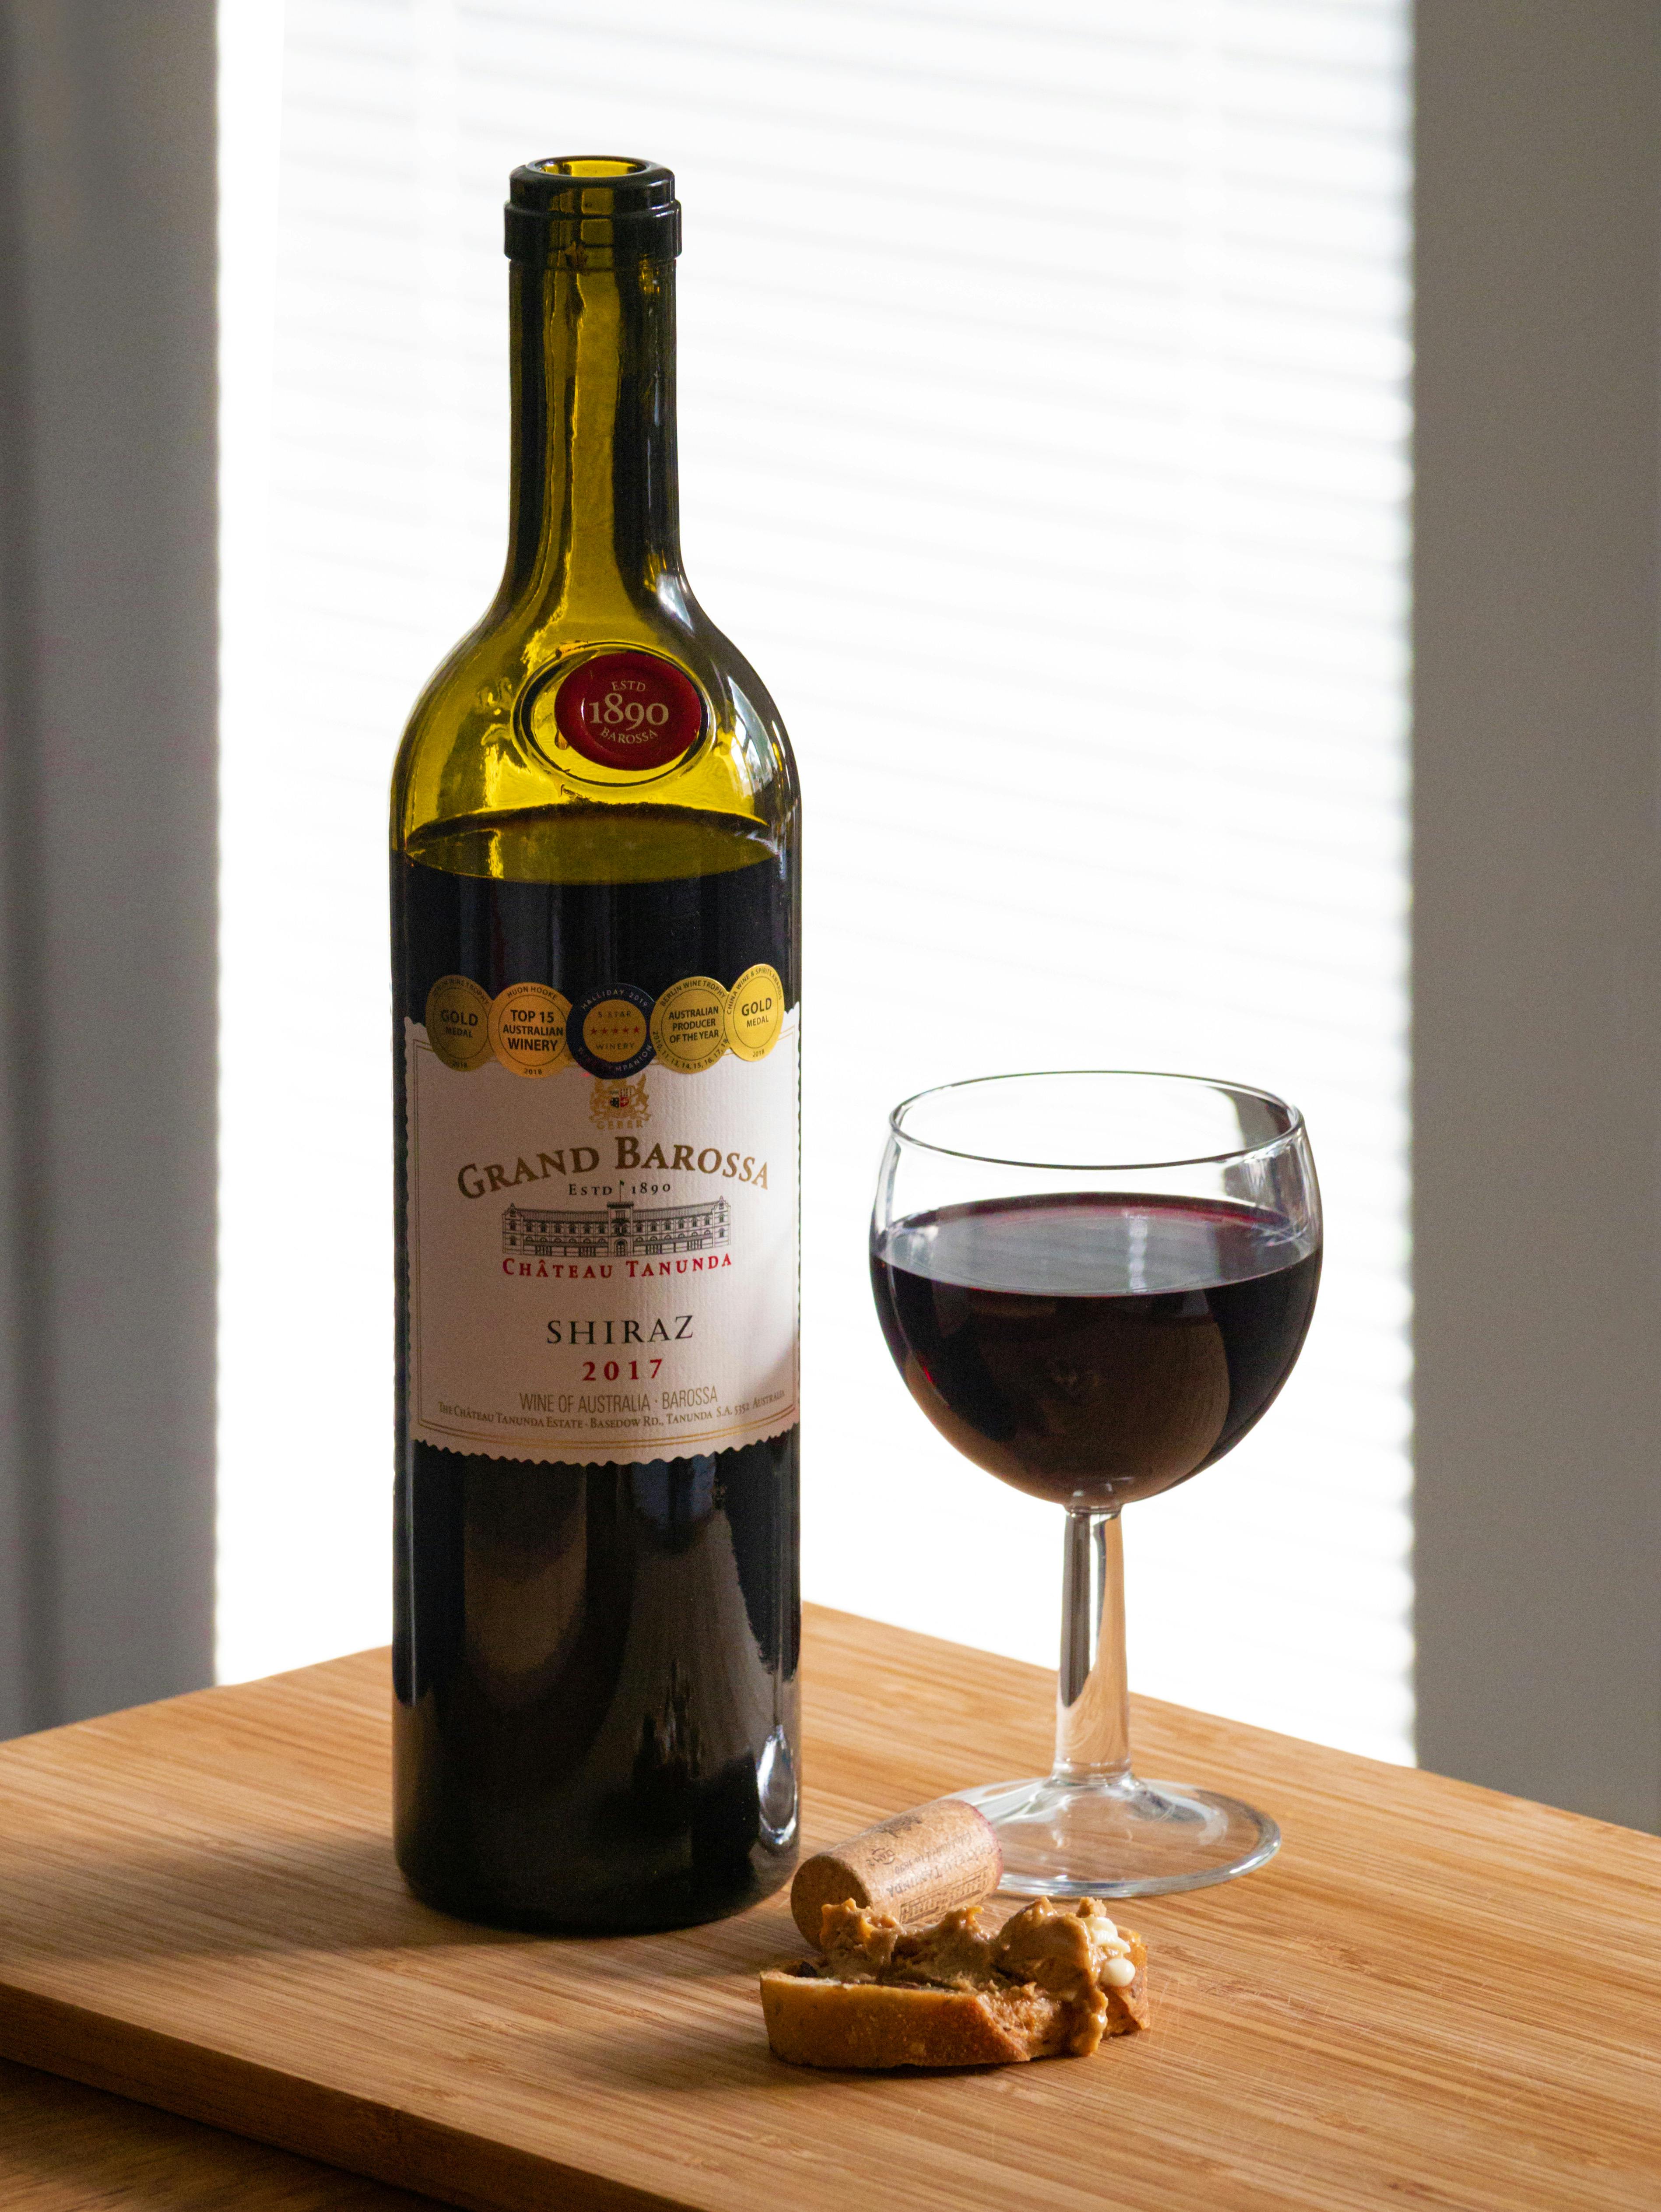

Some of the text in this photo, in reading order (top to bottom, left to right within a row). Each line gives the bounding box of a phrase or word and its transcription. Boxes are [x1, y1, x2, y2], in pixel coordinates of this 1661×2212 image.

[611, 680, 646, 692] ESTD
[589, 693, 669, 731] 1890
[600, 727, 658, 744] BAROSSA
[507, 986, 557, 1000] HUON HOOKE
[581, 989, 648, 1009] HALLIDAY 2019
[660, 980, 726, 1007] BERLIN WINE TROPHY
[727, 992, 737, 1015] CHINA
[736, 974, 749, 990] WINE
[755, 968, 772, 976] SPIRITS
[669, 1006, 719, 1020] AUSTRALIAN
[741, 998, 772, 1016] GOLD
[441, 1009, 478, 1026] GOLD
[510, 1010, 554, 1023] TOP 15
[673, 1019, 716, 1031] PRODUCER
[746, 1016, 769, 1027] MEDAL
[446, 1027, 473, 1038] MEDAL
[503, 1024, 563, 1036] AUSTRALIAN
[670, 1030, 719, 1043] OF THE YEAR
[508, 1038, 558, 1051] WINERY
[525, 1067, 542, 1076] 2018
[457, 1136, 769, 1199] GRAND BAROSSA
[569, 1183, 671, 1196] ESTD 1890
[503, 1253, 733, 1279] CHÂTEAU TANUNDA
[547, 1315, 693, 1345] SHIRAZ
[583, 1358, 663, 1382] 2017
[520, 1386, 718, 1414] WINE OF AUSTRALIA BAROSSA
[496, 1412, 544, 1427] TANUNDA
[547, 1417, 583, 1428] ESTATE
[590, 1418, 641, 1428] BASEDOW
[666, 1411, 713, 1424] TANUNDA
[734, 1403, 750, 1416] 5352
